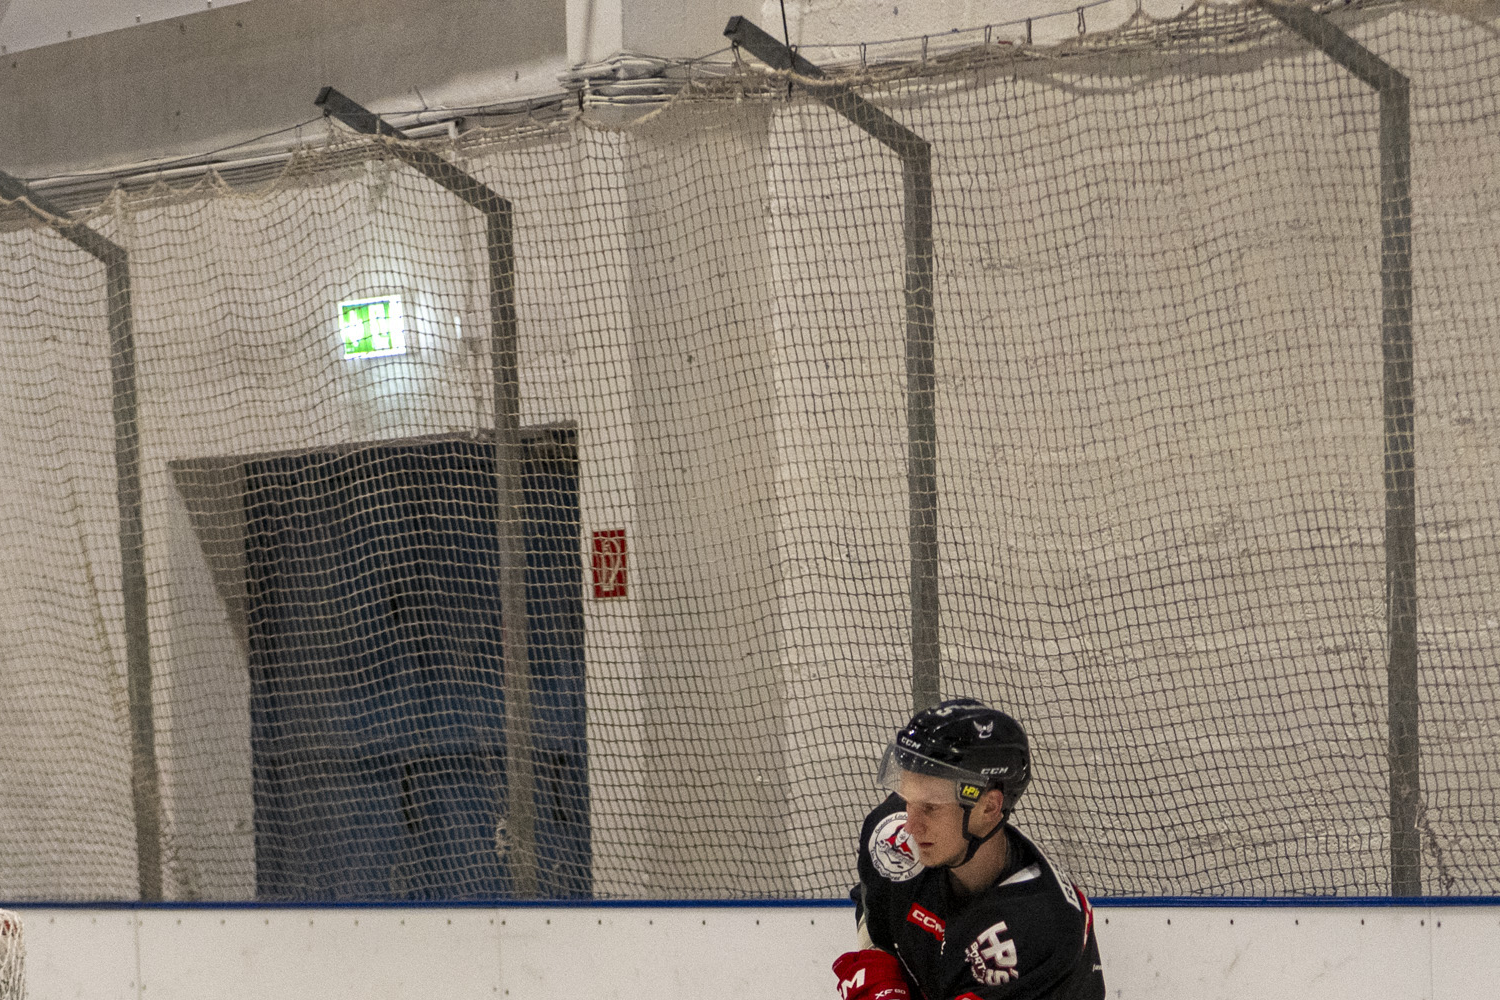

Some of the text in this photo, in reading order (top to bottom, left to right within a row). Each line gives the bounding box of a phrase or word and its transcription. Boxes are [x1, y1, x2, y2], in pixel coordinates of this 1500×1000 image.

[900, 737, 921, 749] CCM
[980, 766, 1009, 775] CCM
[912, 909, 945, 934] CCM
[875, 989, 893, 1000] XF
